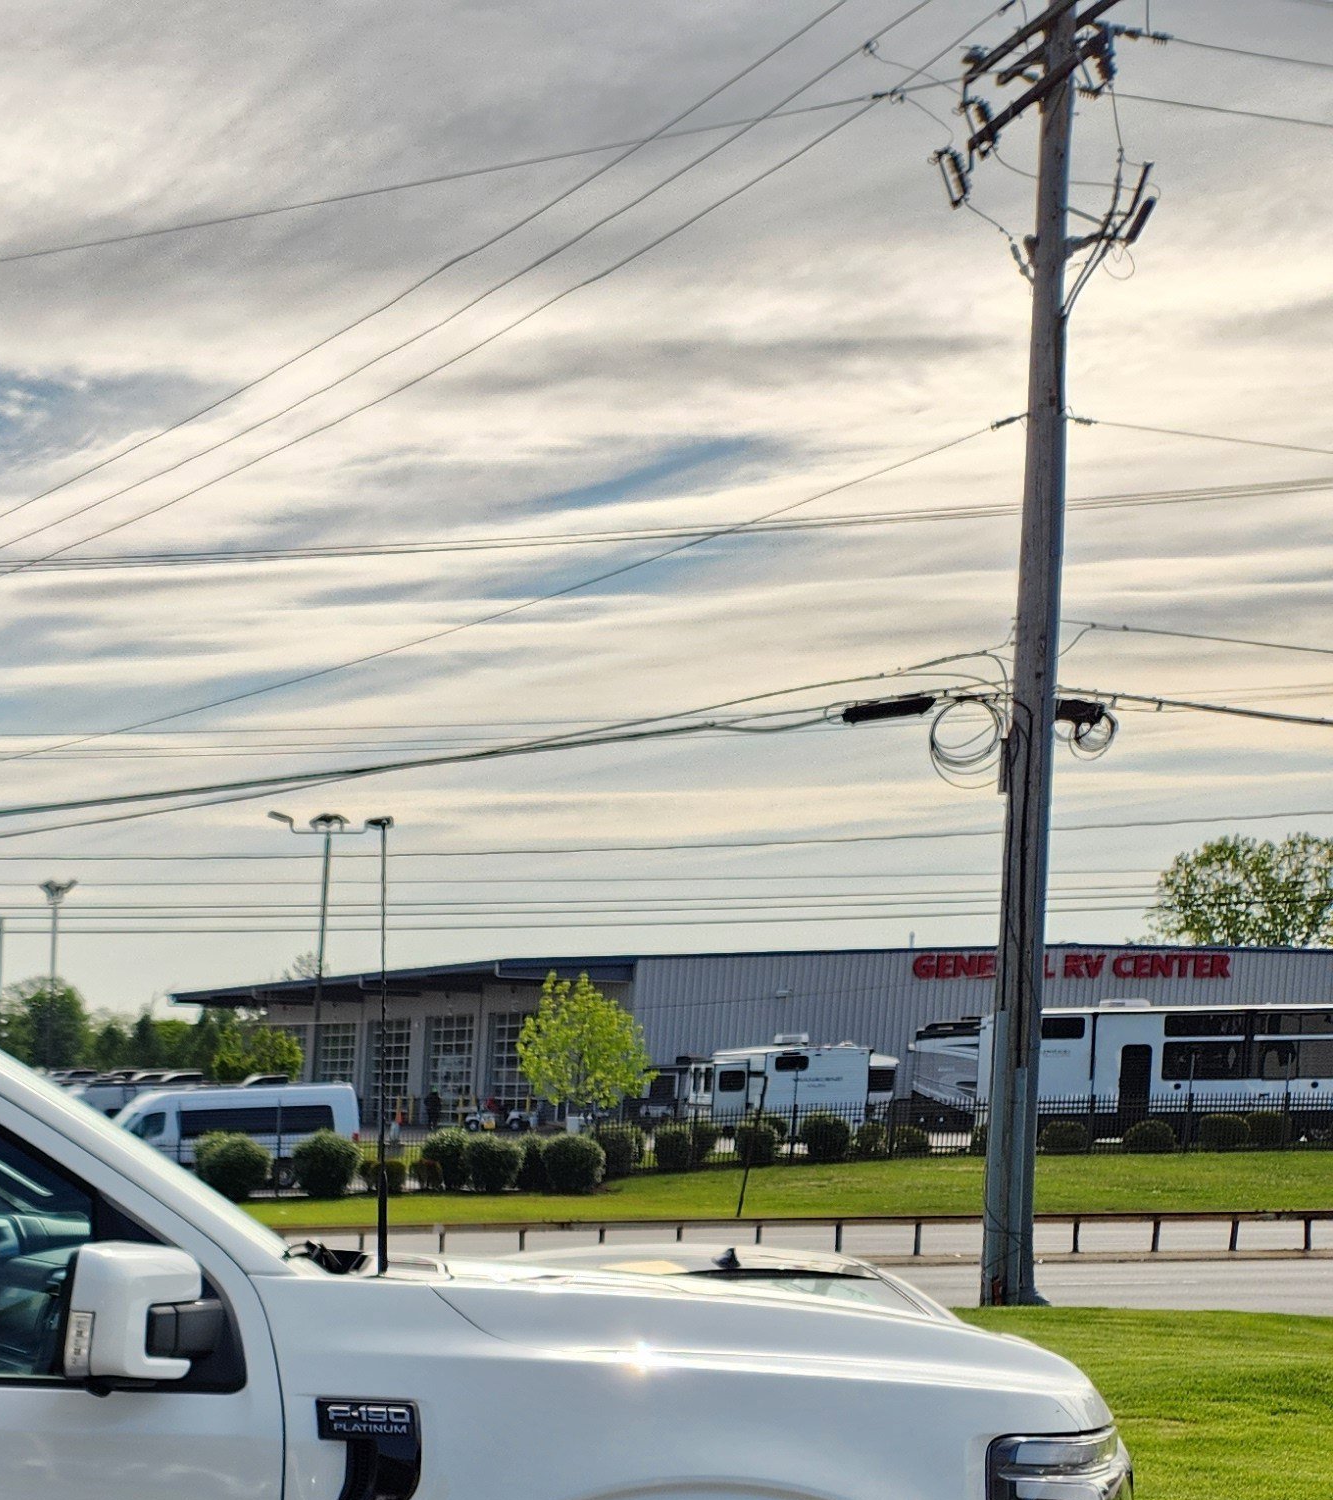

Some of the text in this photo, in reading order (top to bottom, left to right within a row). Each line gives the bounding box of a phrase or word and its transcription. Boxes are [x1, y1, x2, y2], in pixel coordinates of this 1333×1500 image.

[913, 953, 1231, 979] GENEL RV CENTER
[326, 1404, 411, 1423] F-150
[333, 1422, 408, 1434] PLATINUM
